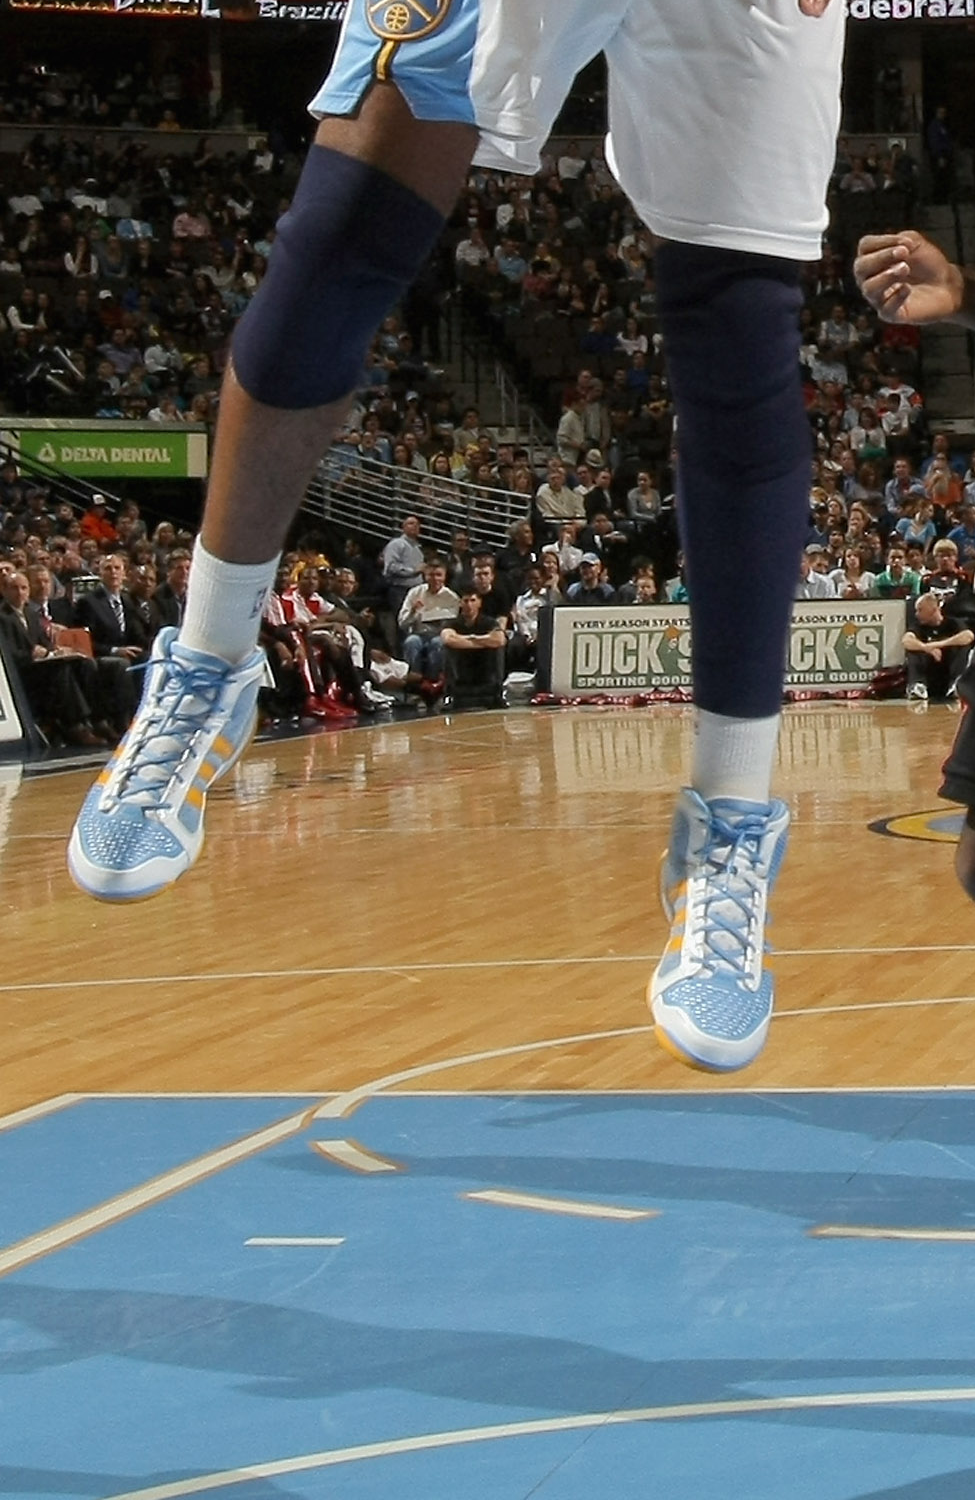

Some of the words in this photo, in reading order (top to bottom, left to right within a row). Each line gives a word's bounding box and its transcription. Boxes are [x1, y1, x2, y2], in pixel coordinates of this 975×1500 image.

[61, 446, 109, 463] DELTA
[110, 447, 172, 464] DENTAL
[573, 619, 606, 630] EVERY
[608, 618, 650, 629] SEASON
[829, 613, 868, 623] STARTS
[870, 613, 884, 623] AT
[576, 675, 647, 688] SPORTING
